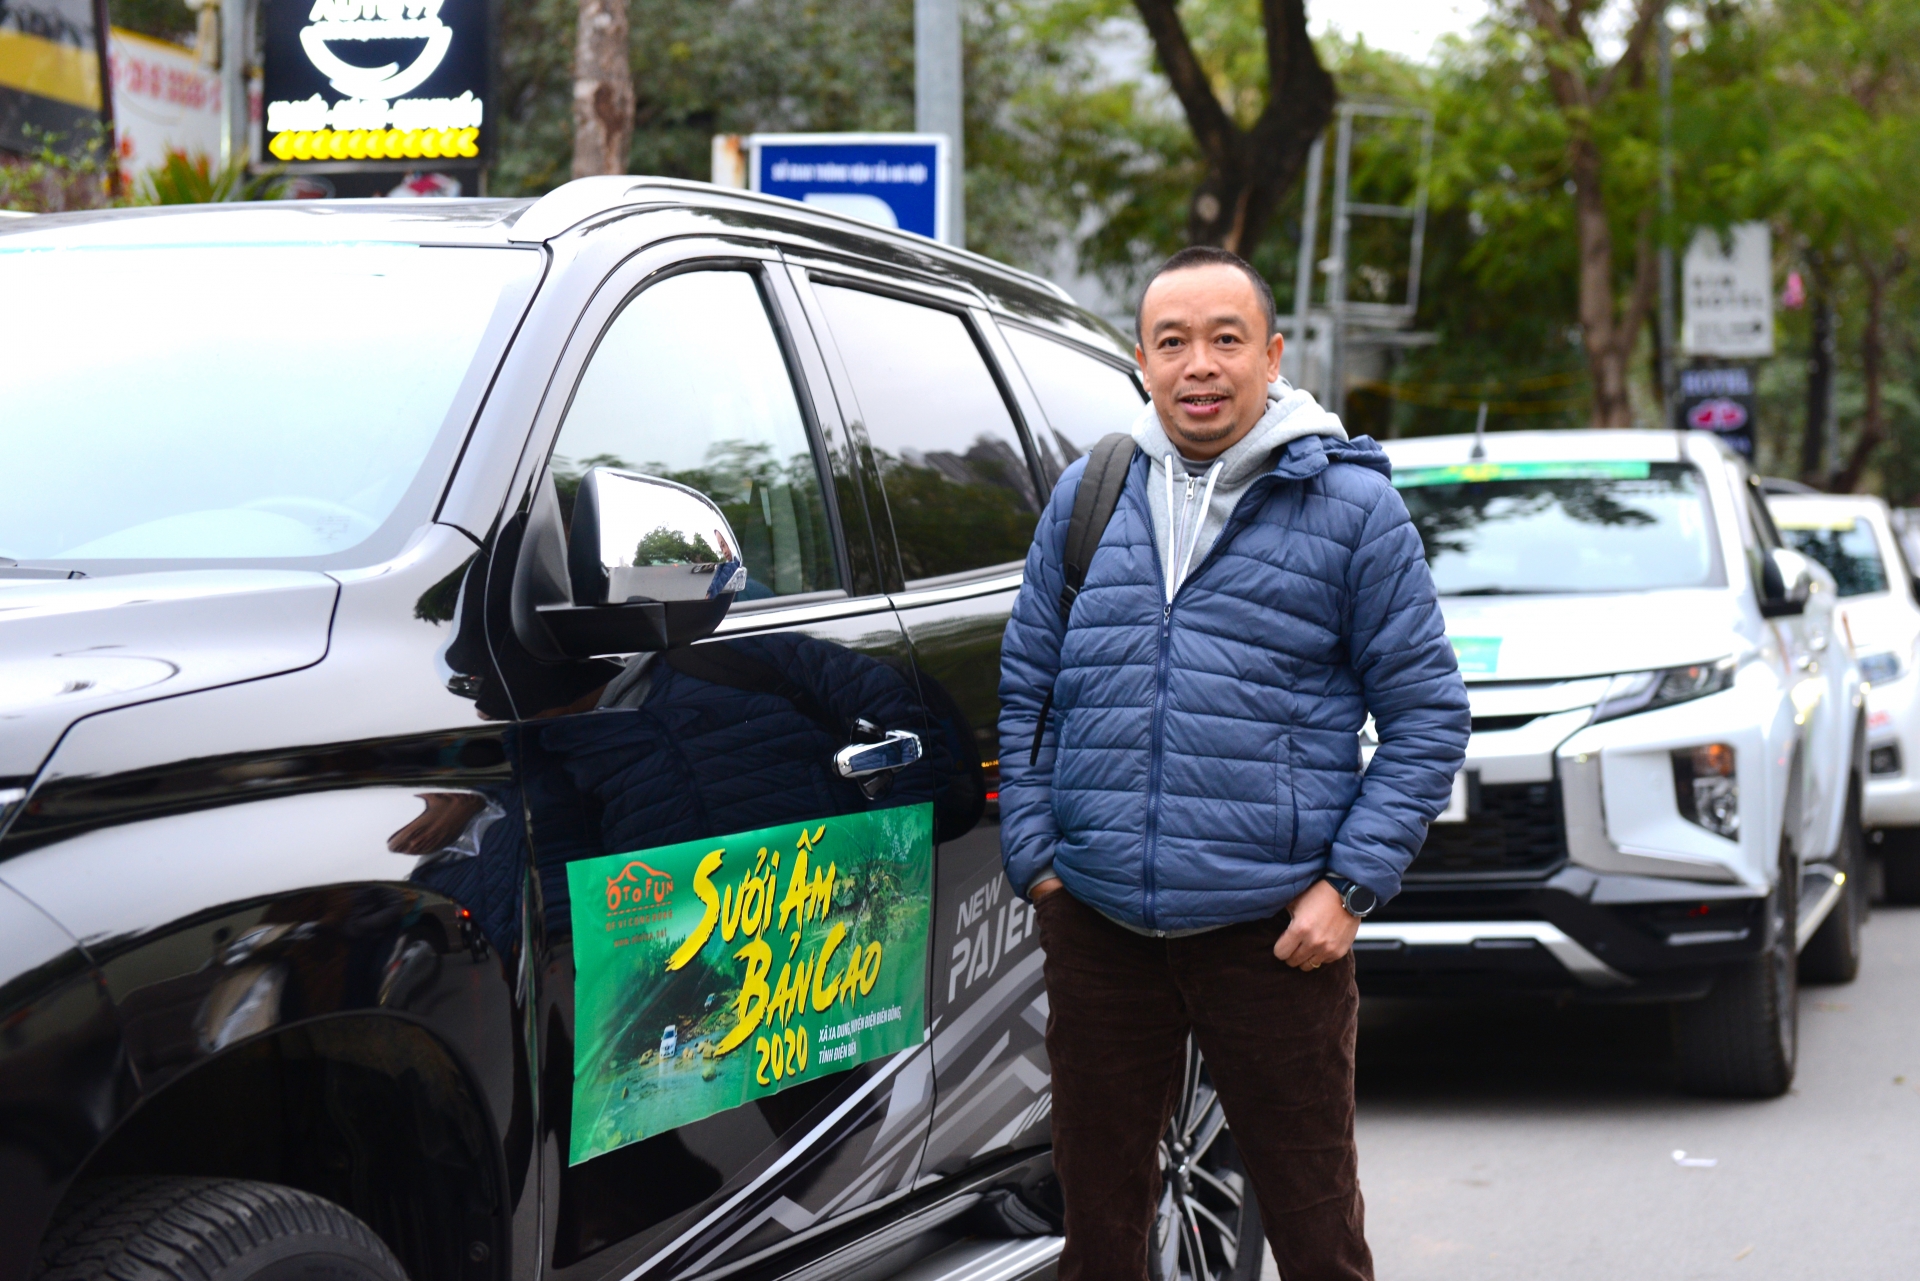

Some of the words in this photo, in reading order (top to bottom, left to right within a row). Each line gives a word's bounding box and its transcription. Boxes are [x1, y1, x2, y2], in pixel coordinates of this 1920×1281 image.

[778, 824, 837, 935] ẤM
[956, 870, 1004, 935] NEW
[713, 928, 814, 1057] BẢN
[812, 921, 882, 1011] CAO
[756, 1024, 808, 1085] 2020
